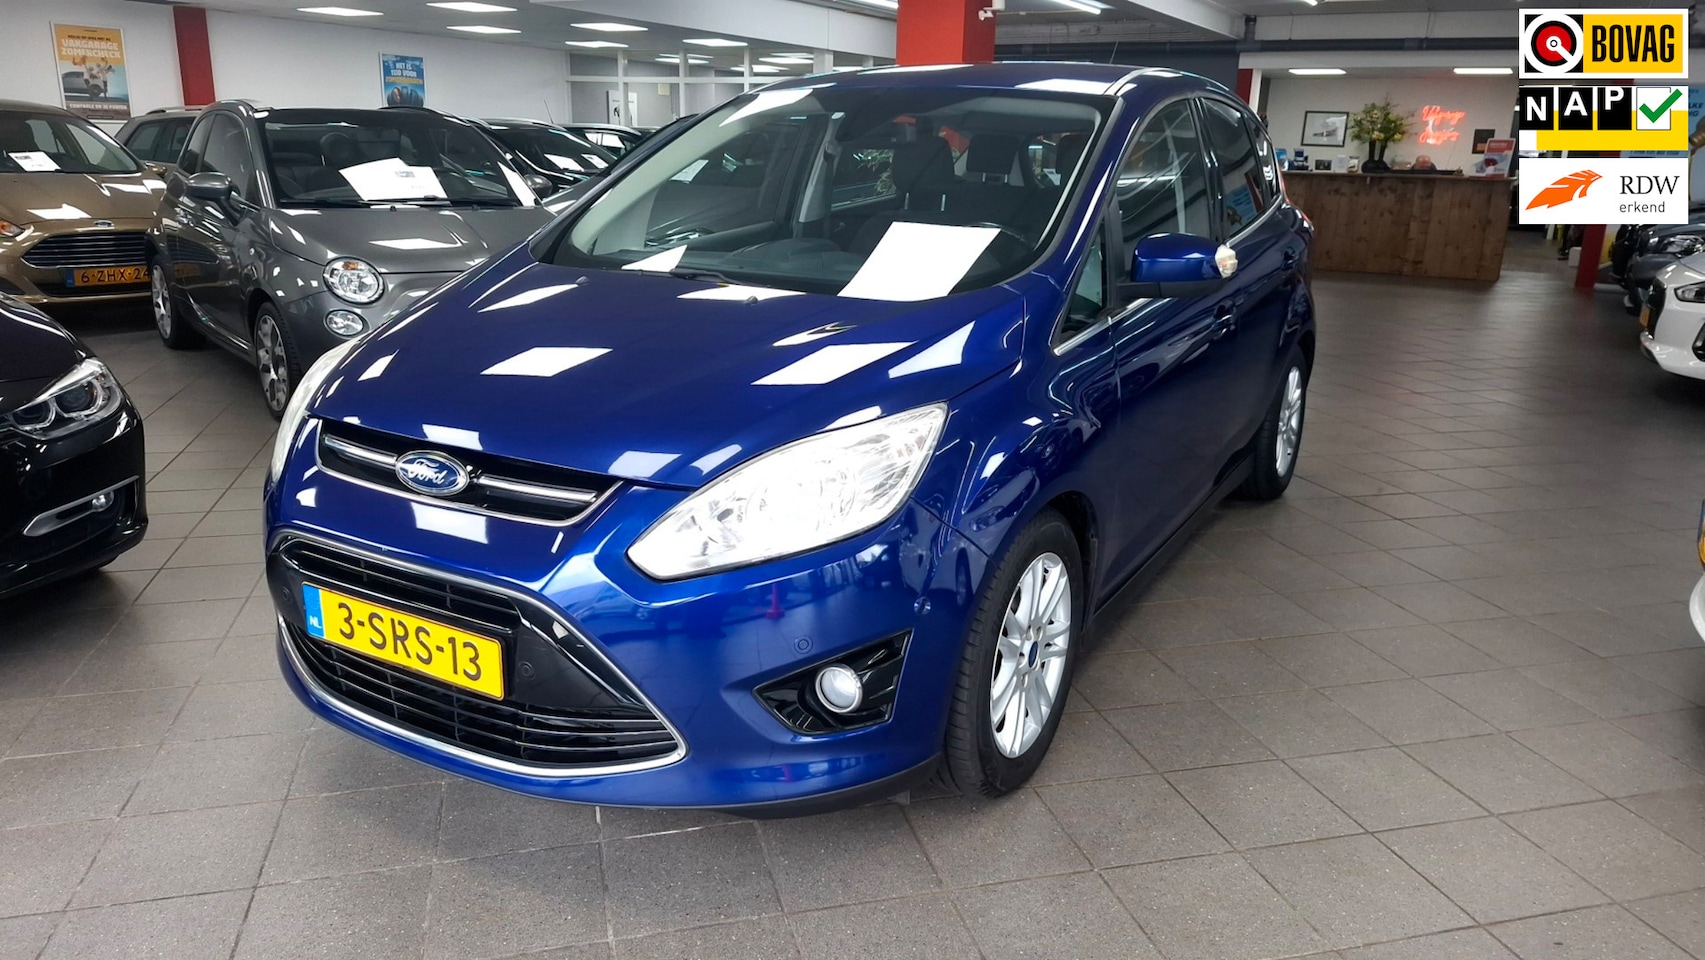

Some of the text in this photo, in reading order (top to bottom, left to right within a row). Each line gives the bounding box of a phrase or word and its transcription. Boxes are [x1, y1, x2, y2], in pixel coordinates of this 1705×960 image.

[62, 39, 118, 50] VAKGARAGE
[61, 47, 121, 58] ZOMERCHECK
[81, 268, 149, 283] 6-ZHX-24
[401, 458, 448, 485] Ford
[309, 615, 322, 629] NL
[338, 602, 482, 681] 3-SRS-13
